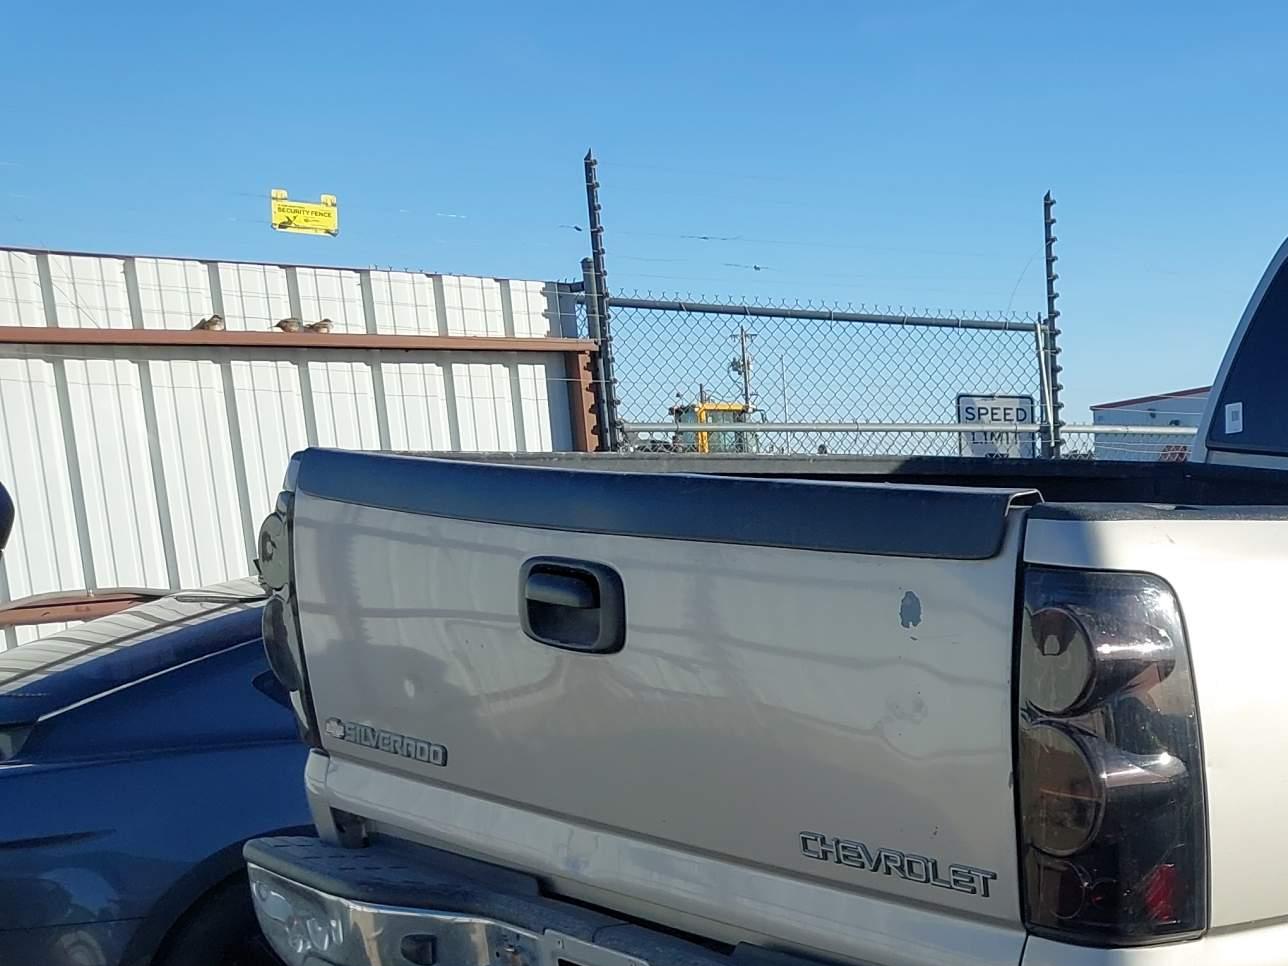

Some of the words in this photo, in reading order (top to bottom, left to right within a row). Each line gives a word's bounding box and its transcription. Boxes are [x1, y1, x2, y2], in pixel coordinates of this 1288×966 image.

[277, 207, 310, 216] SECURITY
[965, 406, 1027, 422] SPEED
[344, 722, 448, 766] SILVERADO
[799, 831, 998, 898] CHEVROLET
